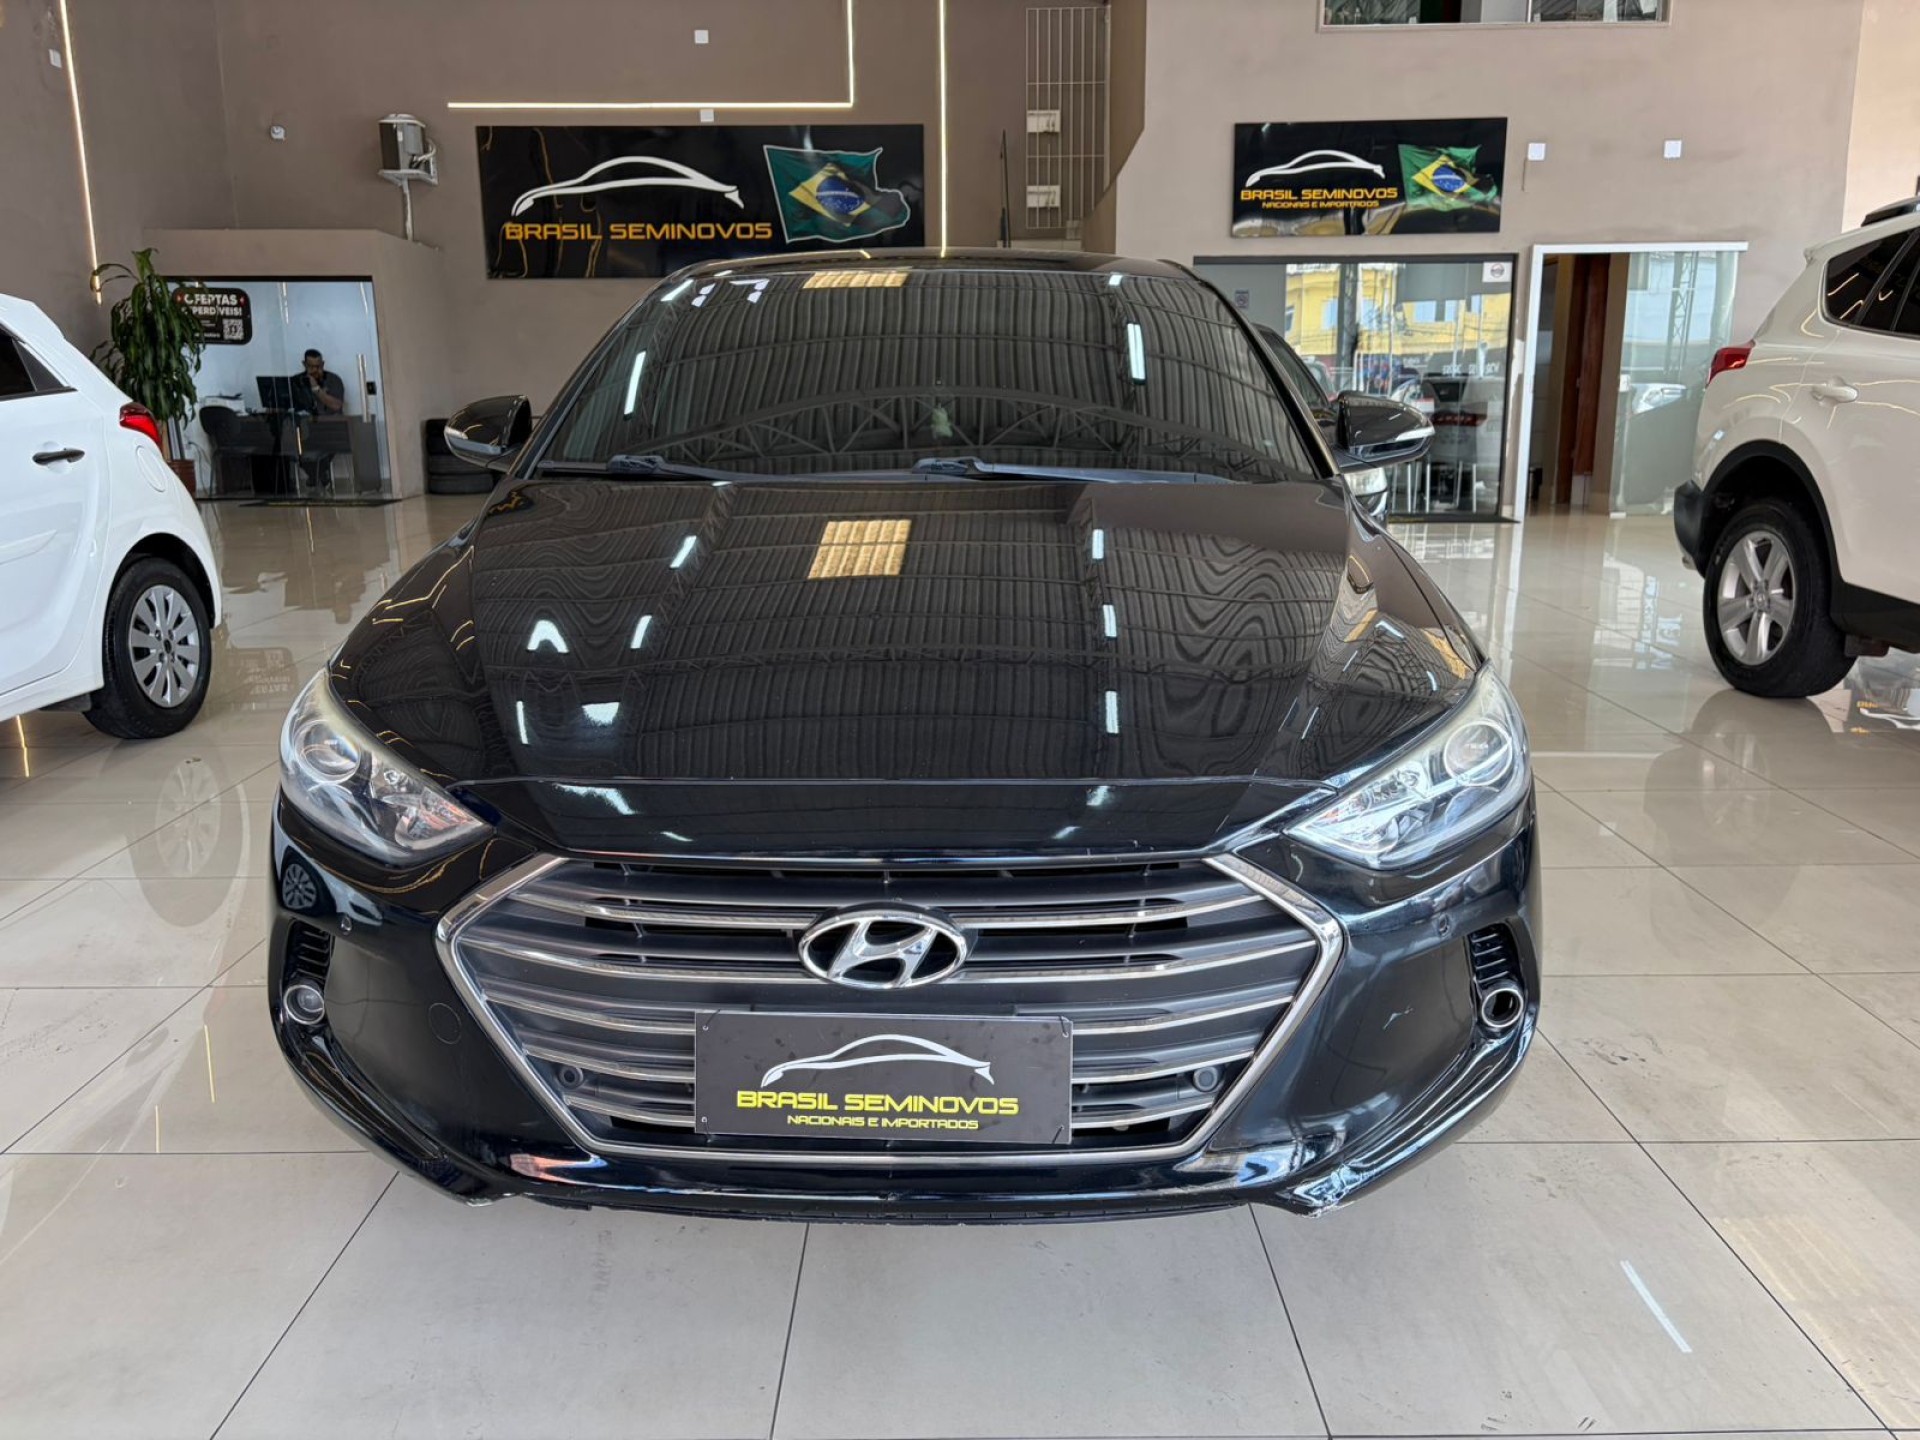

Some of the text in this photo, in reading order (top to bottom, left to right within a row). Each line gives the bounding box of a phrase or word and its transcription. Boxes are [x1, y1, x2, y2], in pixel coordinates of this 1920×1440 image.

[1240, 187, 1398, 200] BRASIL SEMINOVOS
[1262, 201, 1310, 209] NACIONAIS
[1319, 200, 1379, 208] IMPORTADOS
[505, 223, 772, 240] BRASIL SEMINOVOS
[737, 1090, 1019, 1115] BRASIL SEMINOVOS
[787, 1115, 979, 1129] NACIONAIS E IMPORTADOS
